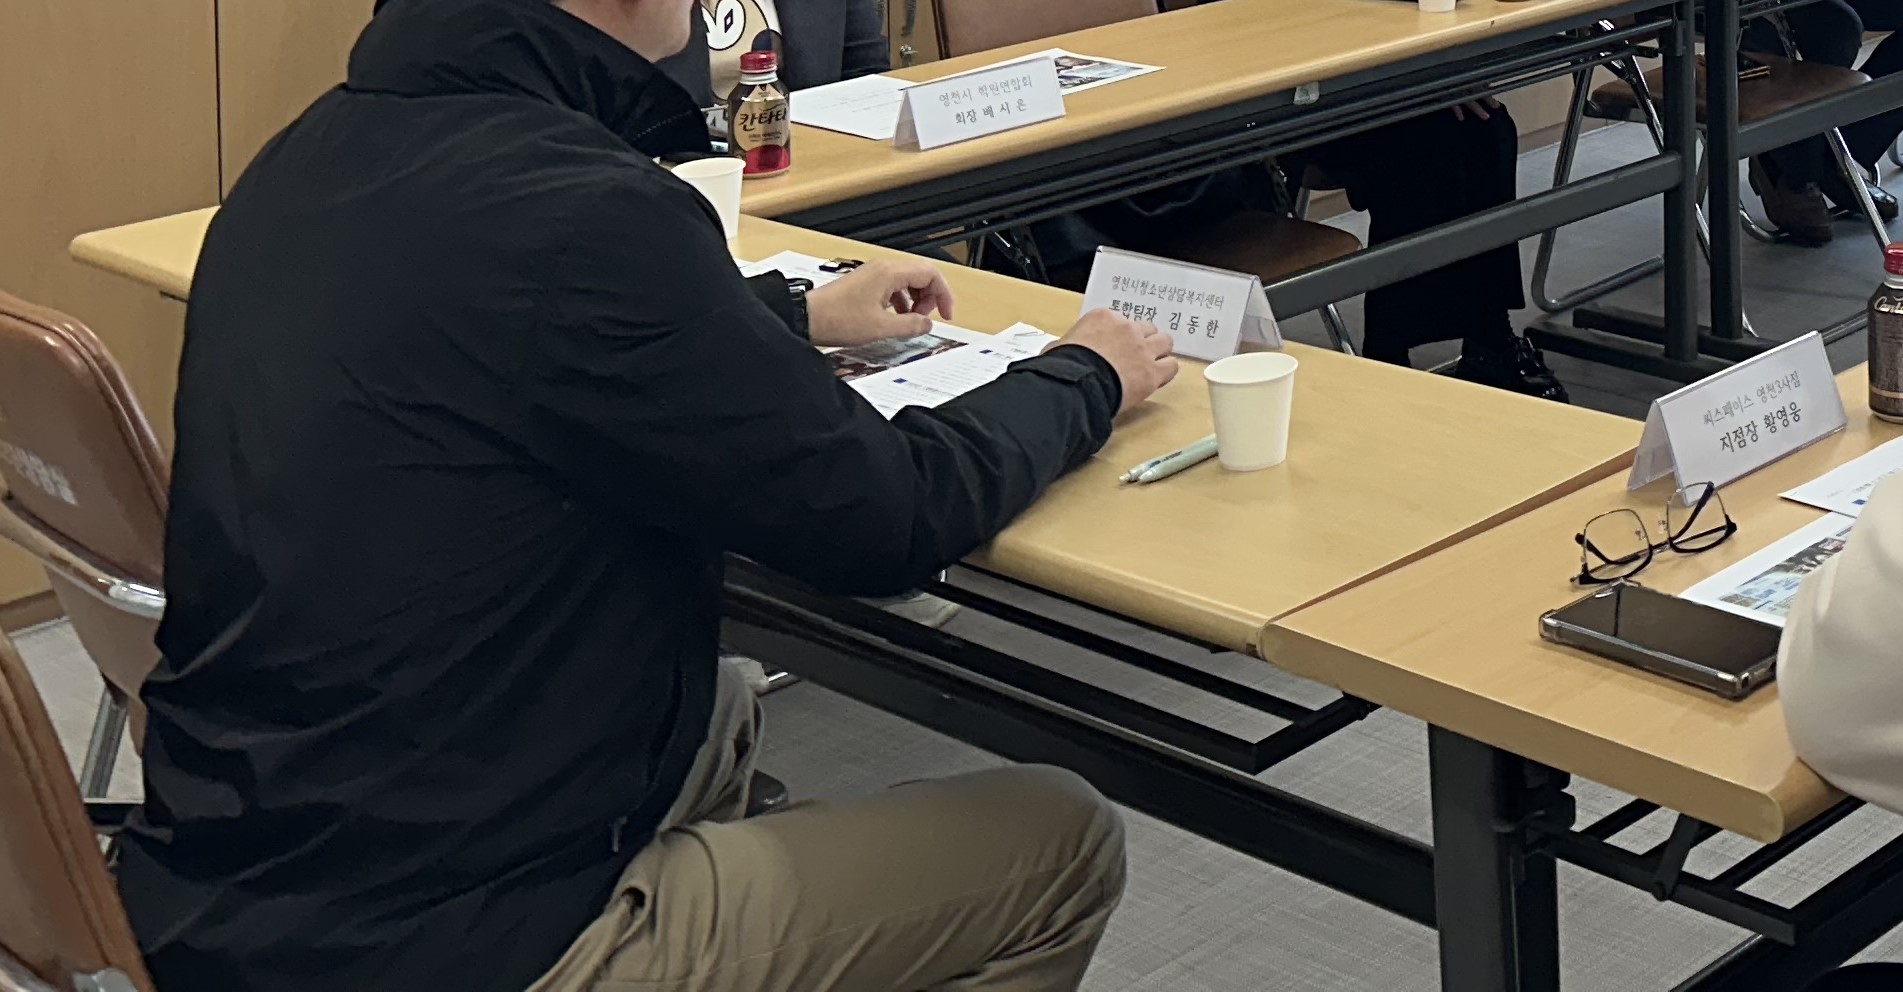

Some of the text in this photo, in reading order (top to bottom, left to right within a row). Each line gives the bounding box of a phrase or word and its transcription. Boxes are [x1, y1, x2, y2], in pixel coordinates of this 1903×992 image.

[938, 86, 973, 108] 영천시
[955, 109, 977, 125] 회장
[1111, 275, 1225, 311] 영천시청소년상담복지센터
[1719, 401, 1802, 453] 지점장 황영웅
